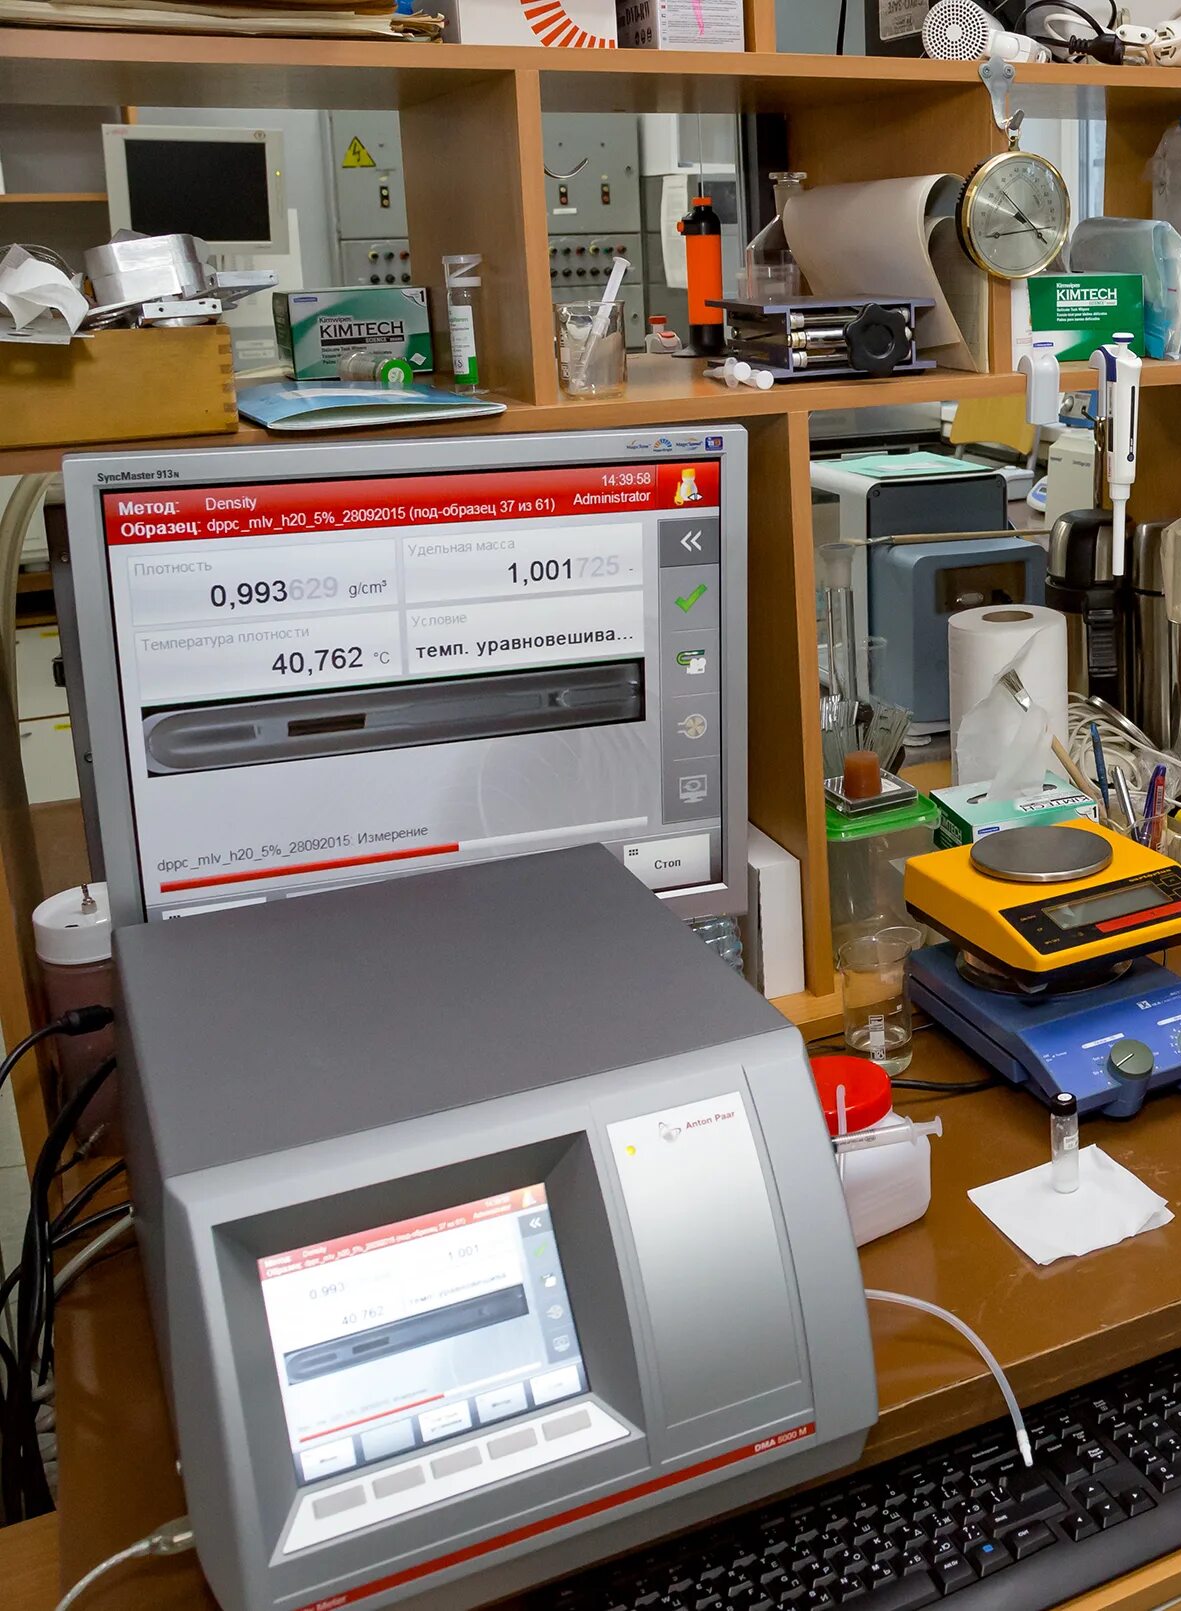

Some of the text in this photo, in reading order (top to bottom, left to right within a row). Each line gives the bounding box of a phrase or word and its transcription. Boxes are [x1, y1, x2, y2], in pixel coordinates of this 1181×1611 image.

[419, 290, 425, 302] 1
[1057, 288, 1117, 300] KIMTECH
[320, 321, 404, 338] KIMTECH
[97, 471, 154, 483] SyncMaster
[602, 473, 651, 487] 14:39:58
[118, 496, 257, 516] Метод: Density
[573, 491, 651, 506] Administrator
[120, 520, 201, 538] Образец:
[409, 502, 496, 519] (под-образец
[500, 499, 515, 513] 37
[518, 501, 532, 512] из
[535, 498, 556, 512] 61)
[407, 539, 515, 557] Удельная масса
[134, 560, 212, 577] Плотность
[411, 613, 468, 628] Условие
[141, 627, 310, 652] Температура плотности
[416, 643, 469, 659] темп.
[271, 646, 391, 676] 40,762 °C
[1092, 806, 1097, 818] 1
[357, 825, 429, 845] Измерение
[654, 856, 682, 871] Стоп
[686, 1111, 735, 1130] Anton Paar
[754, 1439, 776, 1453] DMA
[799, 1426, 807, 1436] M
[1018, 1529, 1029, 1537] Ctrl
